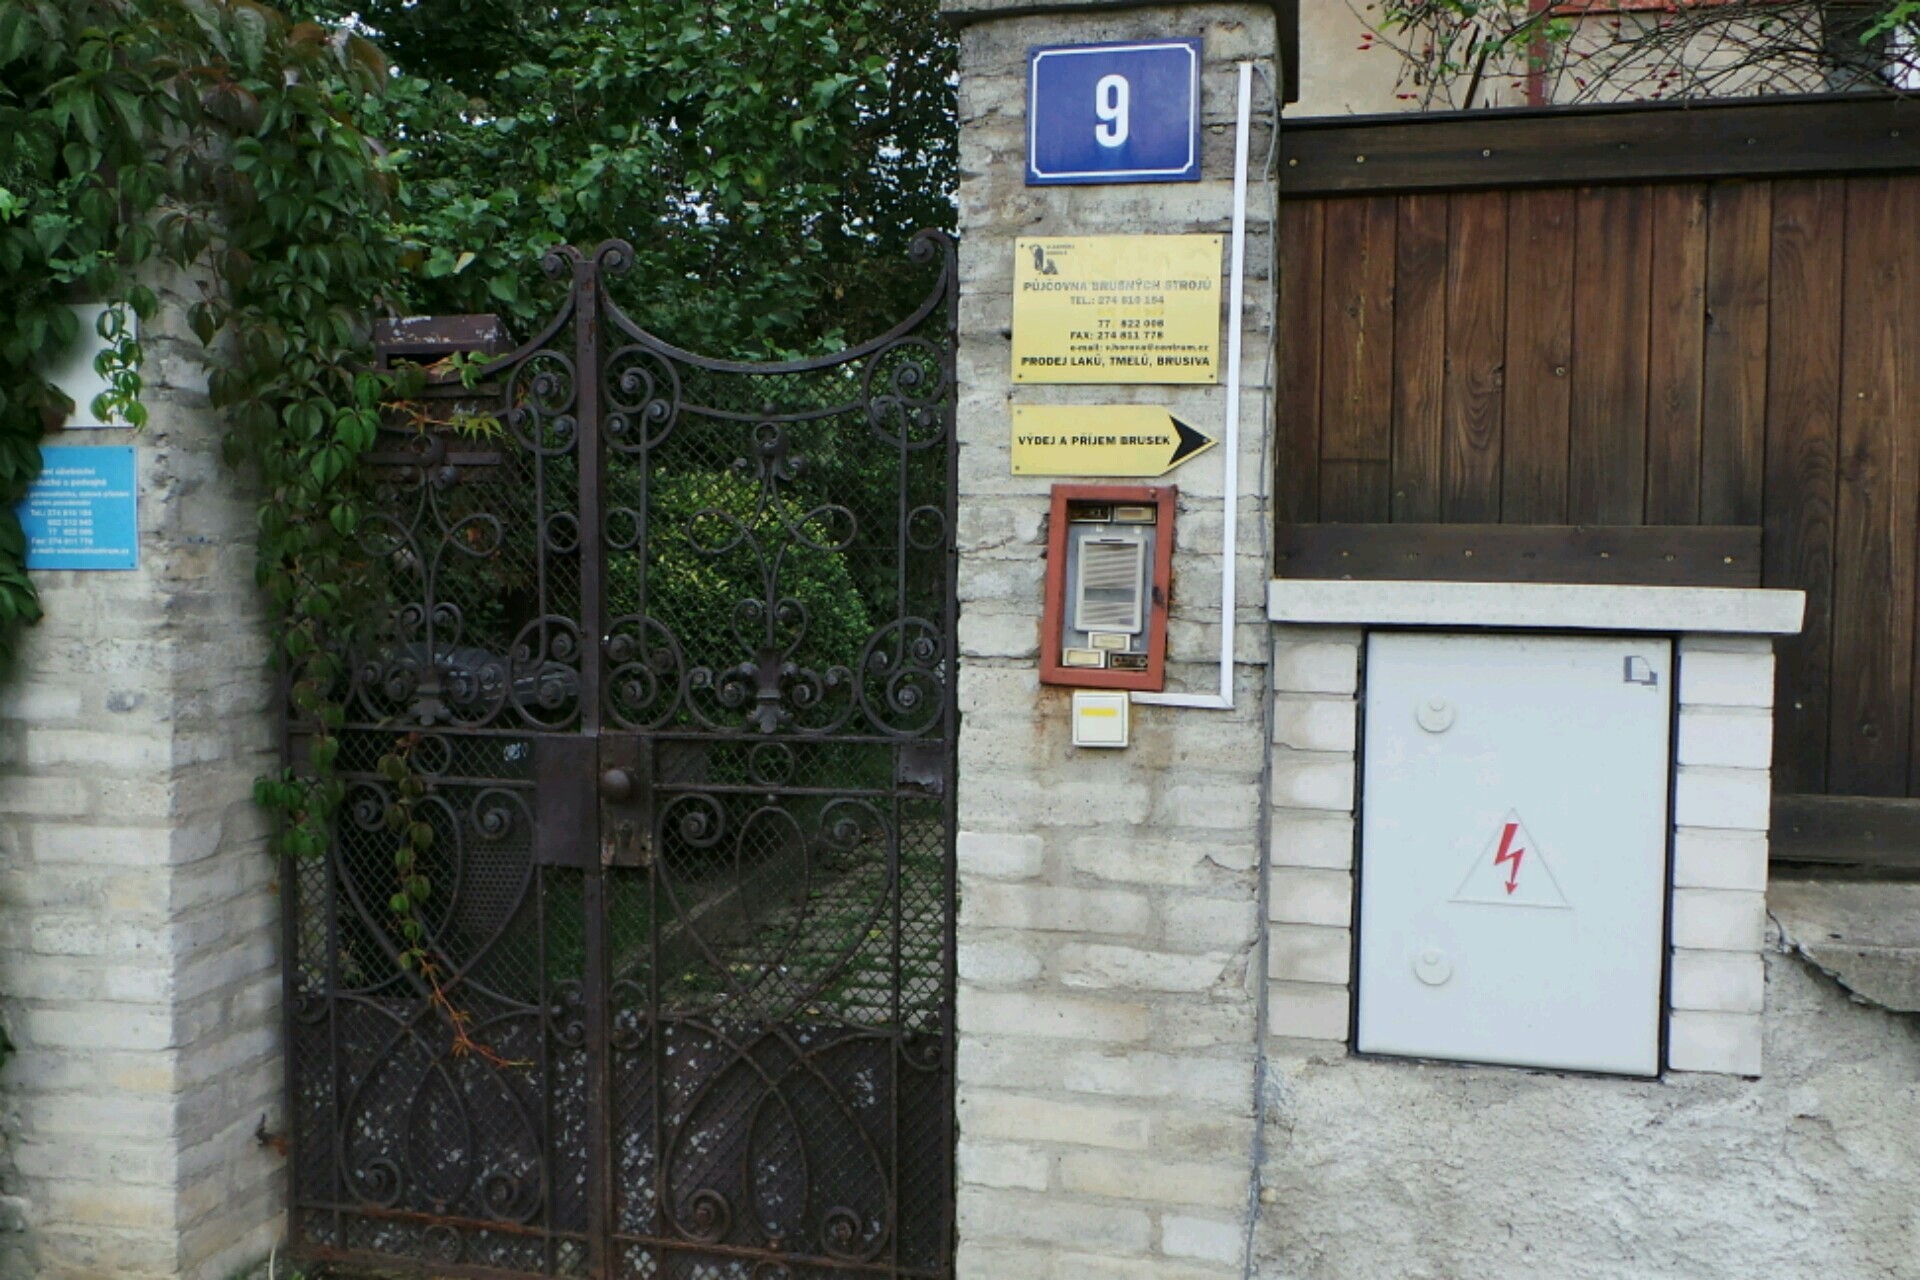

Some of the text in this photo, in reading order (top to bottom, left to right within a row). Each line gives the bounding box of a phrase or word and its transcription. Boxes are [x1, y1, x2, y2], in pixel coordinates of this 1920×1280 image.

[1095, 73, 1130, 148] 9
[1023, 276, 1212, 292] PŮJČOVNA BRUSNÝCH STROJŮ
[1098, 295, 1118, 305] 274
[1020, 353, 1210, 368] PRODEJ LAKŮ, TMELŮ, BRUSIVA
[1018, 432, 1171, 446] VÝDEJ A PŘÍJEM BRUSEK
